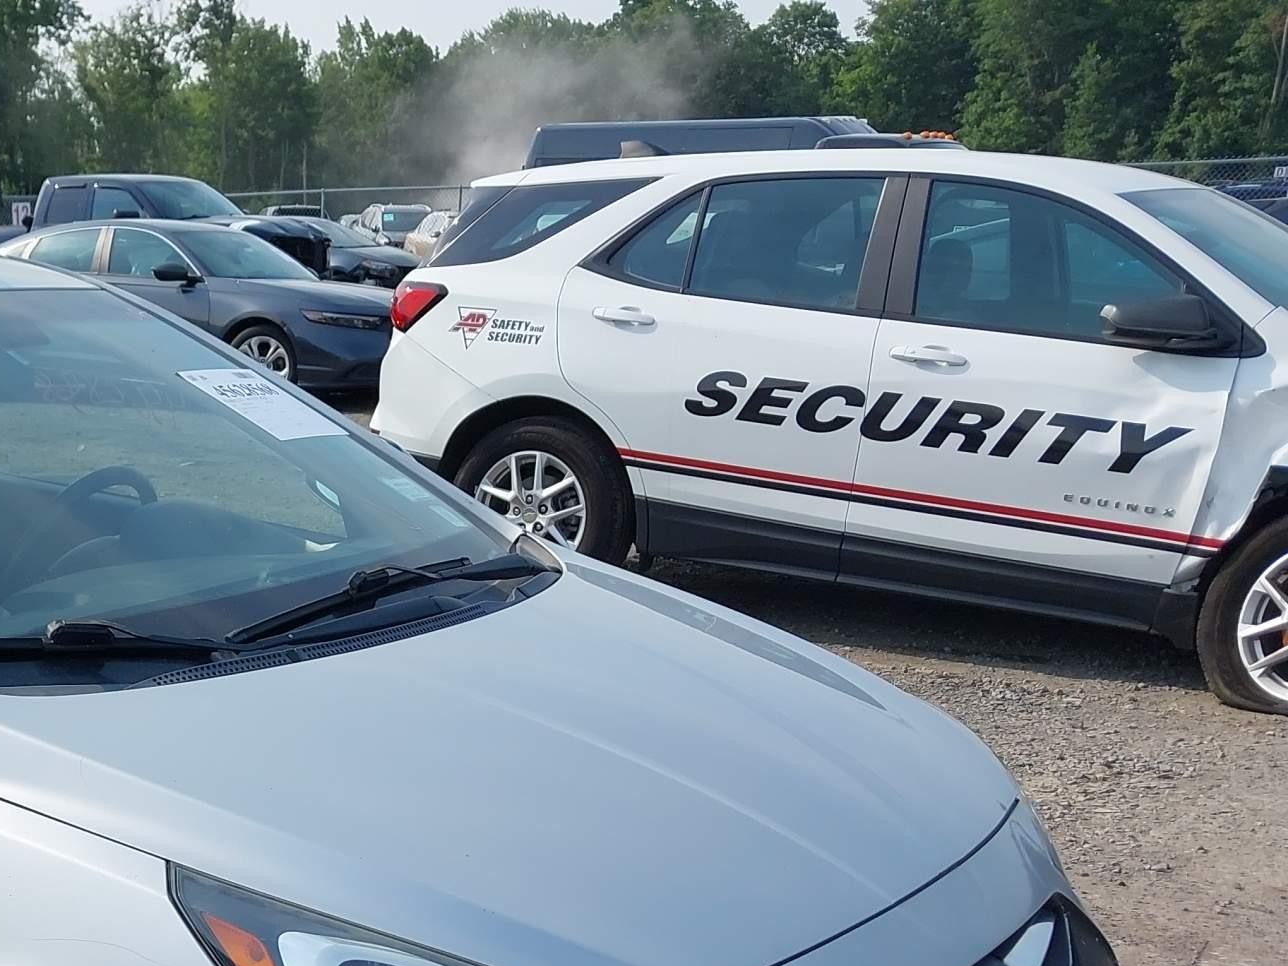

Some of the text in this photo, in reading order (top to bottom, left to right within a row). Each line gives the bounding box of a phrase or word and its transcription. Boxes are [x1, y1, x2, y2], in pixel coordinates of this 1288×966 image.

[491, 318, 545, 333] SAFETY and
[487, 331, 542, 345] SECURITY
[212, 383, 280, 399] 45628568
[684, 370, 1195, 474] SECURITY
[1063, 494, 1177, 518] EQUINOX
